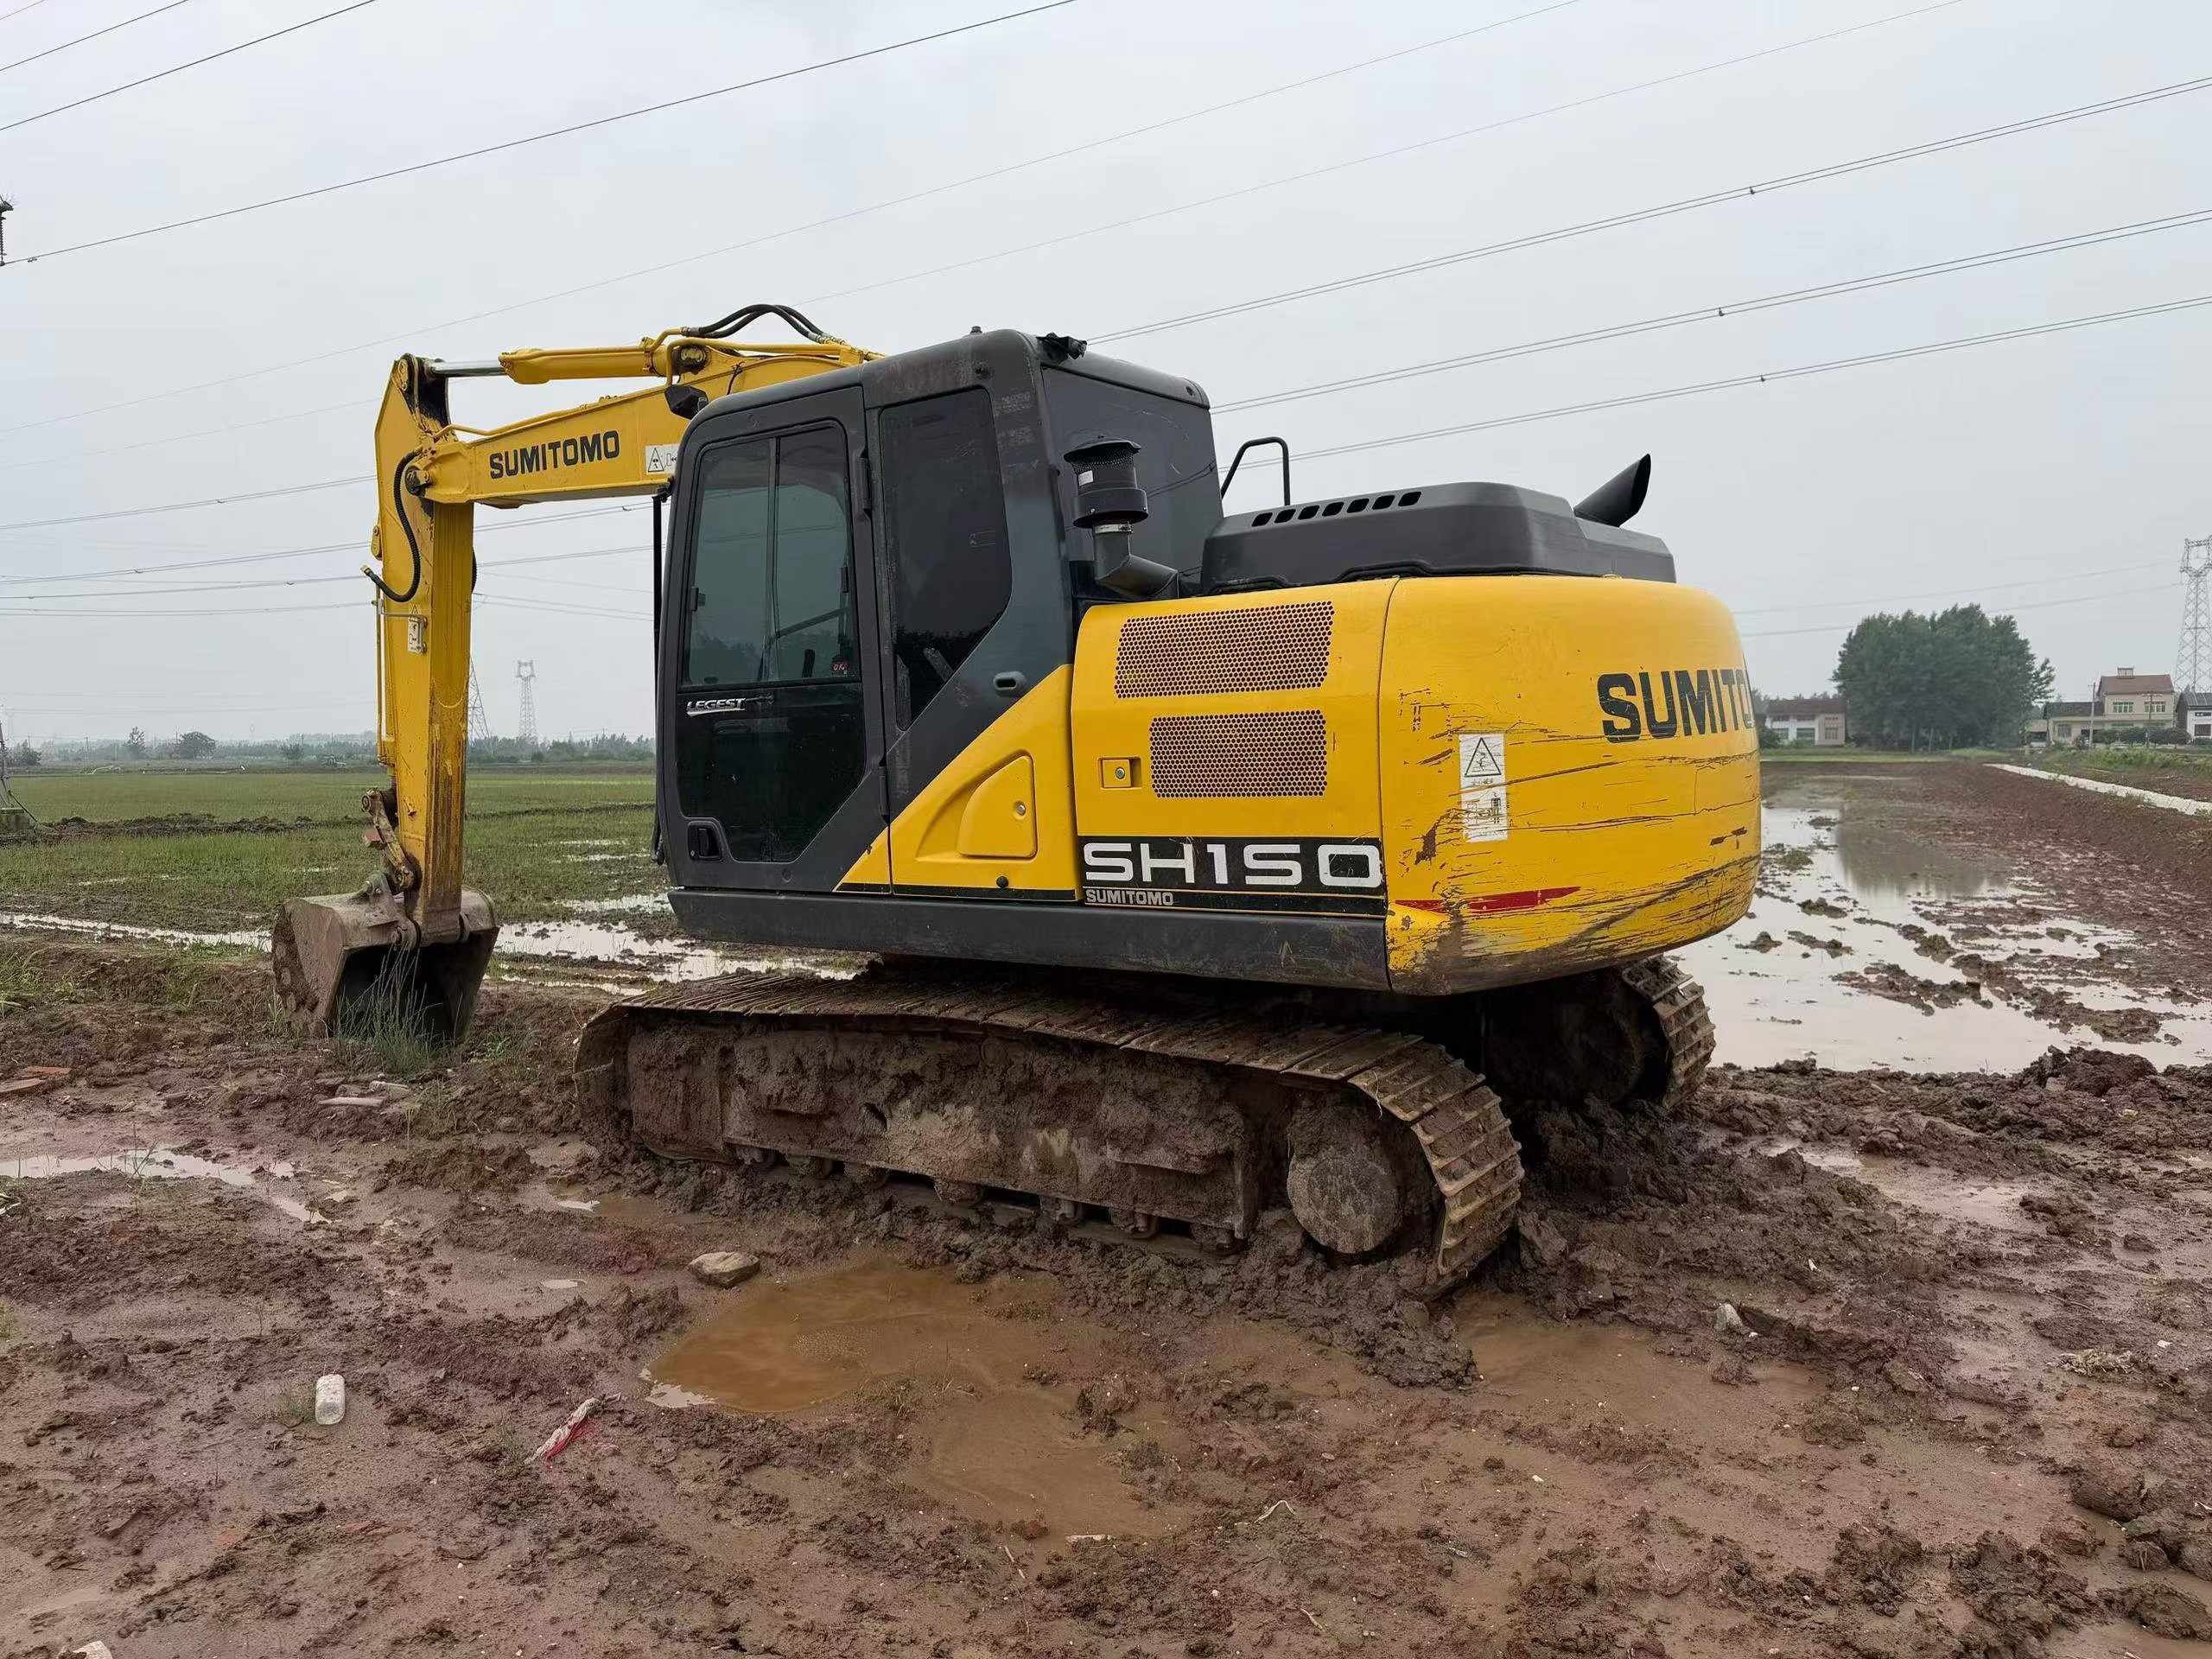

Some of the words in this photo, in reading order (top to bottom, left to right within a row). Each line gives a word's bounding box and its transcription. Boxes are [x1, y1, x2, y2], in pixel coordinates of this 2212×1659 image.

[489, 429, 620, 480] SUMITOMO
[686, 697, 746, 710] LEGEST
[1083, 842, 1382, 888] SH150
[1085, 888, 1174, 906] SUMITOMO
